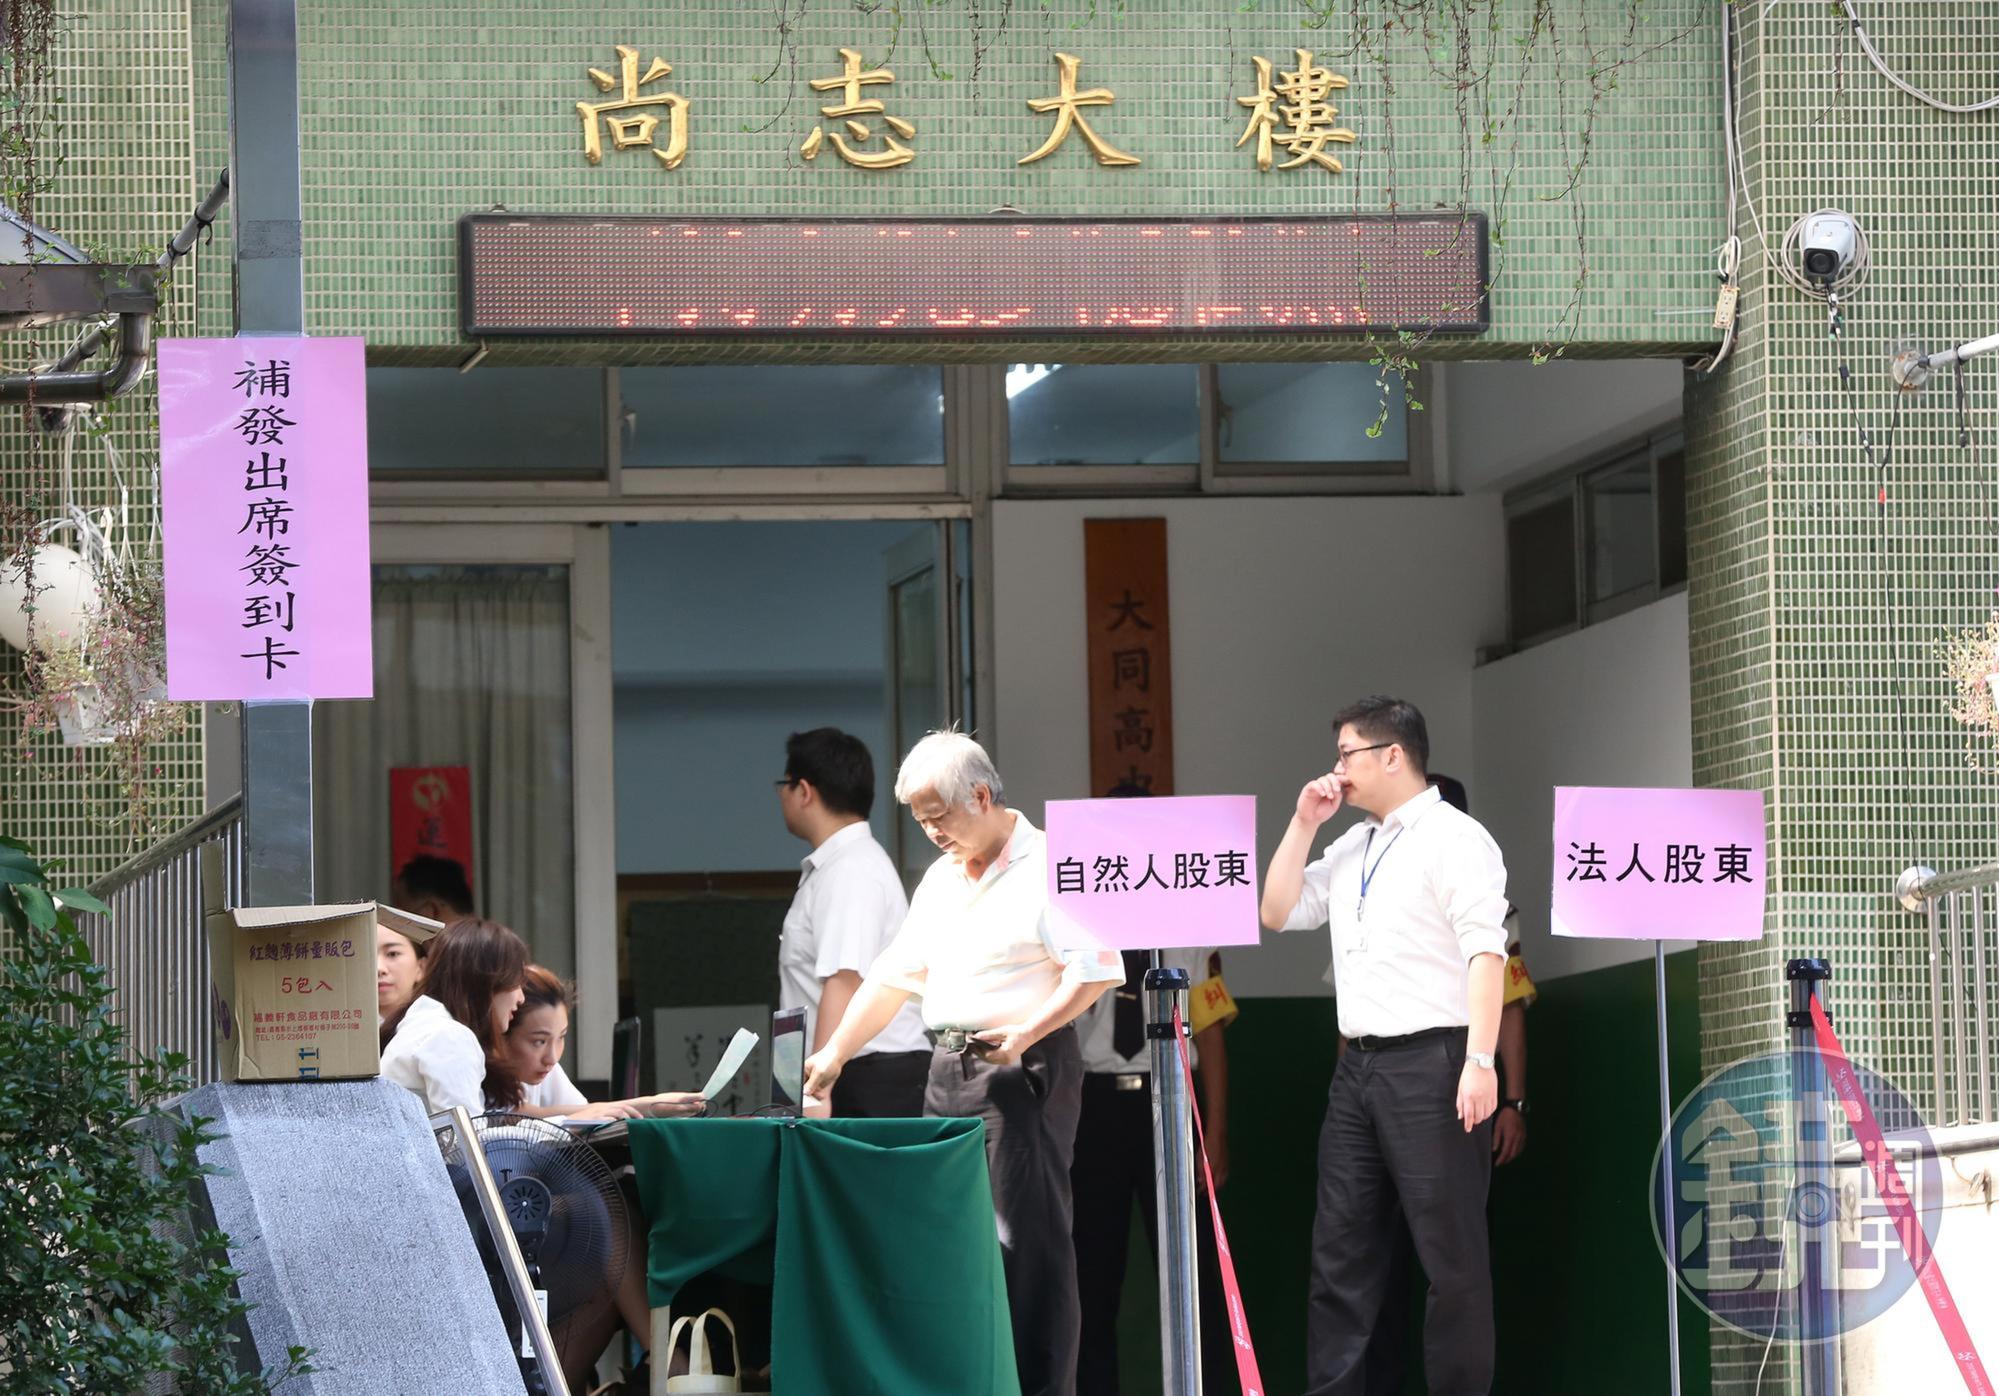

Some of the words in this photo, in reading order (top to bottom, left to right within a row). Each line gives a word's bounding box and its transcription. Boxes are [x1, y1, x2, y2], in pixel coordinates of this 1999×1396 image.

[575, 45, 1357, 173] 尚志大樓
[232, 359, 301, 681] 補發出席簽到卡
[1056, 850, 1251, 894] 自然人股東
[1566, 841, 1754, 884] 法人股東
[281, 976, 334, 994] 5包入
